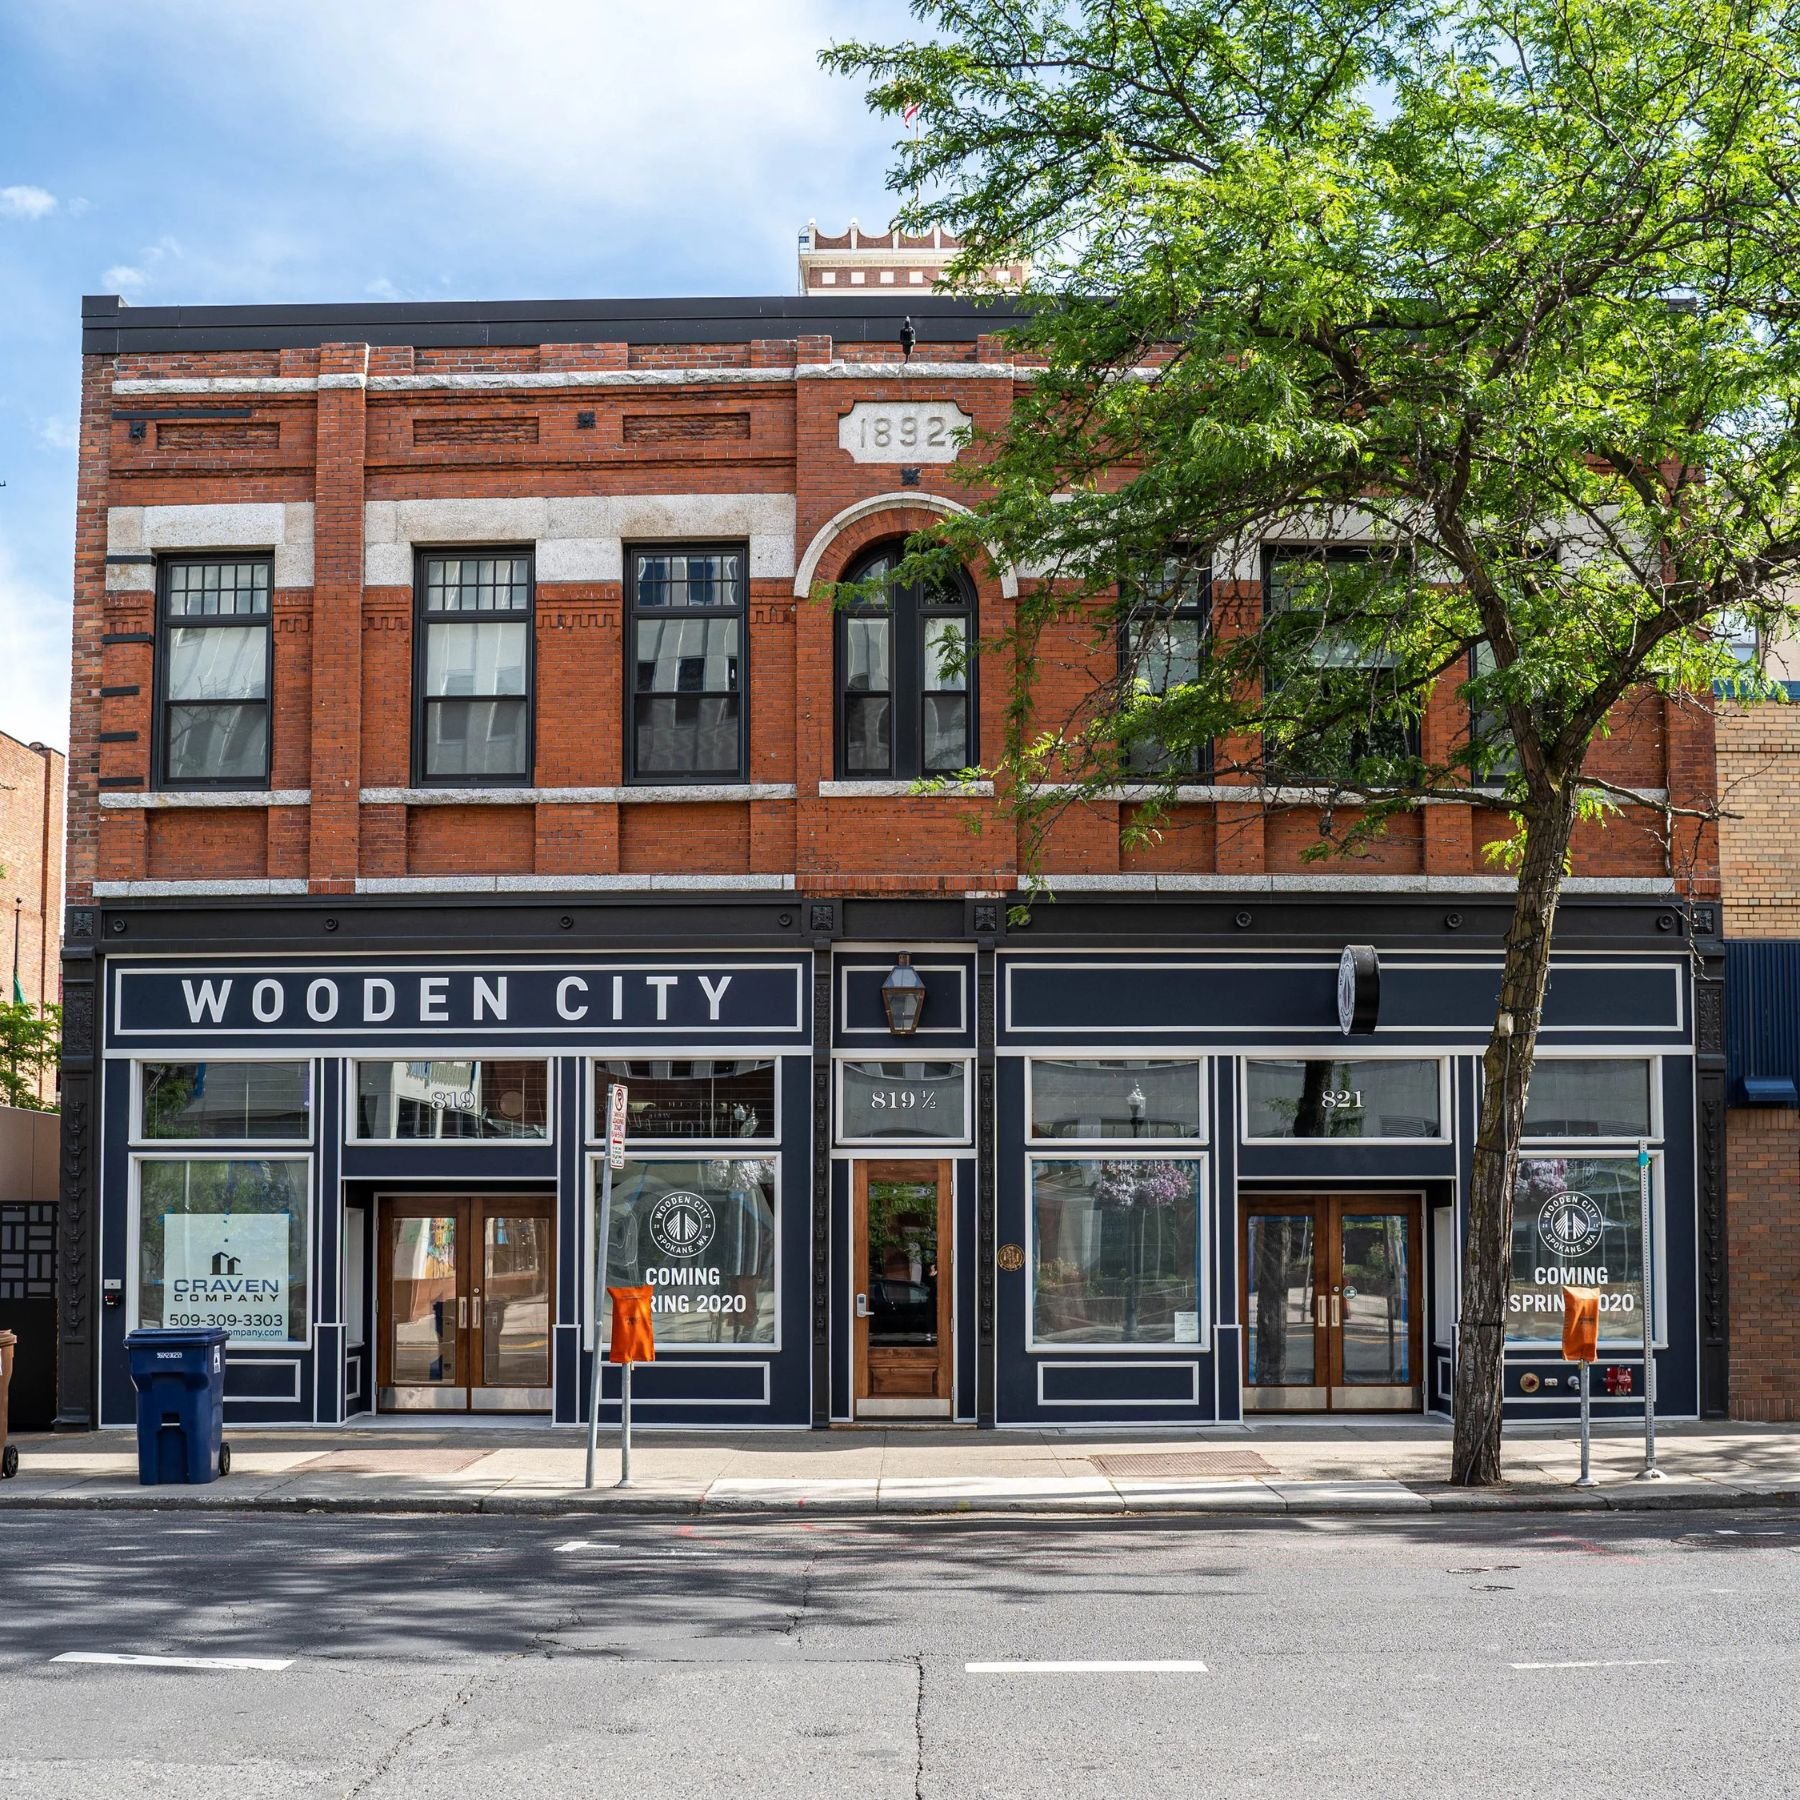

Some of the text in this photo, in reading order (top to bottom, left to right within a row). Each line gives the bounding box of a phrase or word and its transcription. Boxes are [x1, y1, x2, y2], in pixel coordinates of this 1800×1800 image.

[860, 416, 946, 448] 1892
[181, 975, 733, 1024] WOODEN CITY
[431, 1091, 476, 1110] 819
[871, 1091, 916, 1109] 819
[1321, 1090, 1365, 1108] 821
[655, 1195, 711, 1219] WOODEN CITY
[1543, 1195, 1598, 1218] WOODEN CITY
[696, 1235, 709, 1247] WA
[1584, 1234, 1597, 1246] WA
[645, 1267, 720, 1286] COMING
[1535, 1267, 1608, 1285] COMING
[173, 1279, 280, 1293] CRAVEN
[174, 1294, 279, 1302] COMPANY
[650, 1294, 746, 1313] RING 2020
[1509, 1294, 1634, 1313] SPRIN 020
[168, 1313, 283, 1327] 509-309-3303
